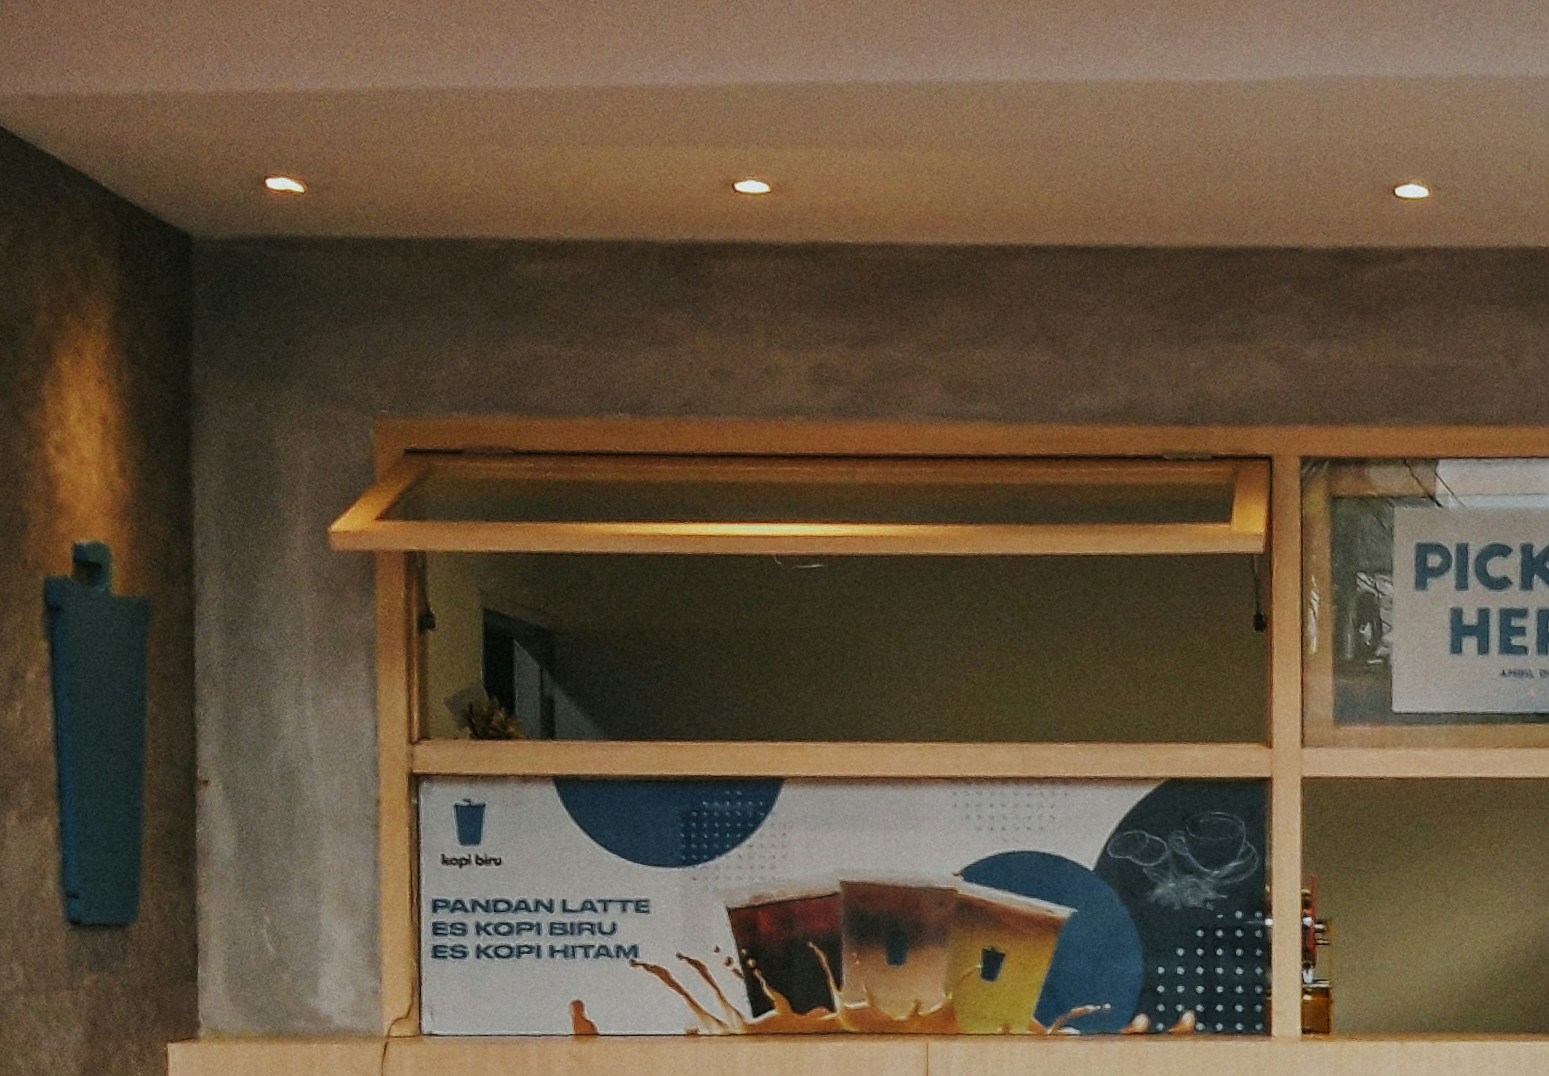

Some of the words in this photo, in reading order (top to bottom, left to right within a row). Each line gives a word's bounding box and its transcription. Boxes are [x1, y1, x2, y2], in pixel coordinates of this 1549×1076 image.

[440, 853, 472, 869] kopi
[474, 853, 502, 866] biru
[431, 898, 555, 914] PANDAN
[561, 898, 651, 914] LATTE
[431, 921, 468, 937] ES
[474, 921, 542, 937] KOPI
[548, 921, 618, 937] BIRU
[431, 943, 468, 960] ES
[475, 943, 542, 960] KOPI
[548, 943, 640, 960] HITAM
